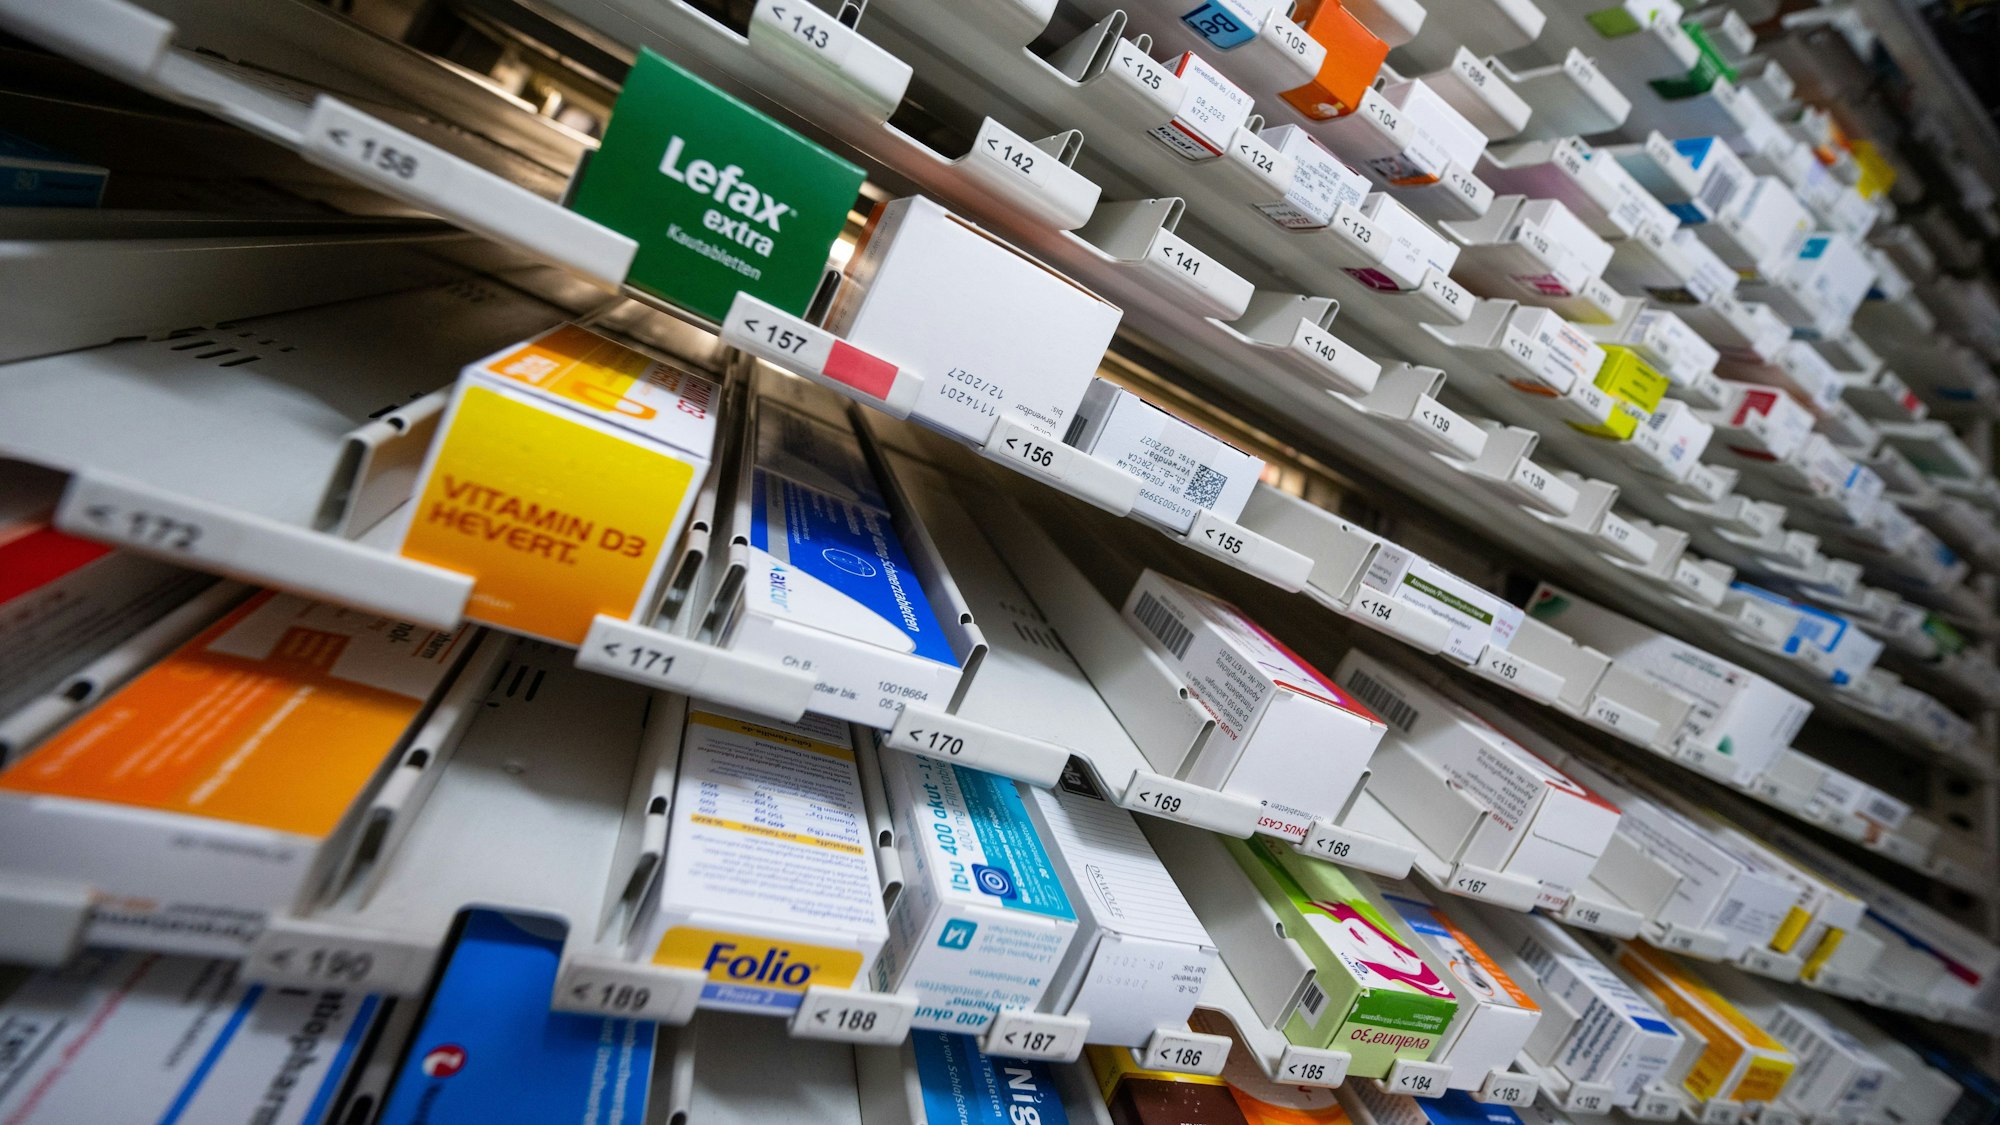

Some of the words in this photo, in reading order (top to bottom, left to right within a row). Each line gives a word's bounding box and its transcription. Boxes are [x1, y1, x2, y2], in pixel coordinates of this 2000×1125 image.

[793, 16, 829, 48] 143
[1286, 32, 1307, 55] 105
[1136, 64, 1162, 90] 125
[1376, 109, 1397, 131] 104
[361, 139, 420, 180] 158
[1004, 146, 1034, 174] 142
[1252, 151, 1274, 174] 124
[658, 136, 791, 232] Lefax
[1460, 179, 1478, 199] 103
[703, 209, 775, 257] extra
[1351, 223, 1372, 244] 123
[1532, 235, 1549, 254] 102
[666, 223, 762, 281] Kautabletten
[1177, 252, 1202, 275] 141
[1442, 286, 1460, 304] 122
[767, 325, 807, 353] 157
[1315, 340, 1336, 362] 140
[1517, 342, 1534, 360] 121
[947, 365, 1005, 399] 12/2027
[939, 383, 997, 418] 1114201
[1014, 403, 1058, 428] Verwendbar
[1432, 413, 1450, 433] 139
[1023, 442, 1054, 468] 156
[1139, 434, 1175, 457] 02/2027
[1126, 451, 1156, 470] 12RCCA
[1142, 448, 1191, 476] Verwendbar
[1177, 453, 1196, 467] bis:
[1167, 483, 1181, 494] SN:
[1529, 472, 1547, 491] 138
[1138, 487, 1191, 518] 04150033998
[443, 474, 595, 542] VITAMIN
[599, 527, 646, 558] D3
[130, 510, 201, 550] 172
[1217, 531, 1243, 554] 155
[1372, 601, 1392, 621] 154
[629, 647, 677, 676] 171
[1500, 663, 1518, 680] 153
[876, 680, 928, 701] 10018664
[1202, 674, 1231, 701] Laichingen
[1213, 656, 1262, 702] Apothekenpflichtig
[813, 681, 838, 695] dbar
[878, 697, 906, 713] 05.2
[1221, 680, 1256, 712] Filmtablette
[1225, 697, 1250, 721] D-89150
[1218, 721, 1239, 741] ALIUD
[929, 732, 965, 755] 170
[934, 756, 959, 810] Filmtable
[921, 779, 948, 821] akut
[1154, 793, 1182, 813] 169
[1500, 785, 1528, 808] Tablette
[987, 805, 1001, 830] Fieber
[1269, 801, 1313, 819] Filmtabletten
[1257, 815, 1283, 830] CAST
[1490, 812, 1514, 832] ALIUD
[933, 819, 959, 858] 400
[1328, 840, 1351, 858] 168
[946, 858, 971, 895] Ibu
[1001, 841, 1026, 889] Schmerzen
[1467, 879, 1488, 894] 167
[309, 948, 376, 982] 190
[705, 942, 811, 986] Folio
[1027, 977, 1040, 987] 20
[600, 985, 650, 1012] 189
[837, 1009, 877, 1032] 188
[913, 1003, 952, 1023] akut
[955, 1010, 988, 1028] 400
[943, 1044, 953, 1062] von
[1022, 1031, 1056, 1052] 187
[1175, 1049, 1202, 1067] 186
[1300, 1063, 1325, 1080] 185
[983, 1066, 1002, 1118] Tabletten
[1412, 1076, 1433, 1091] 184
[1502, 1087, 1520, 1101] 183
